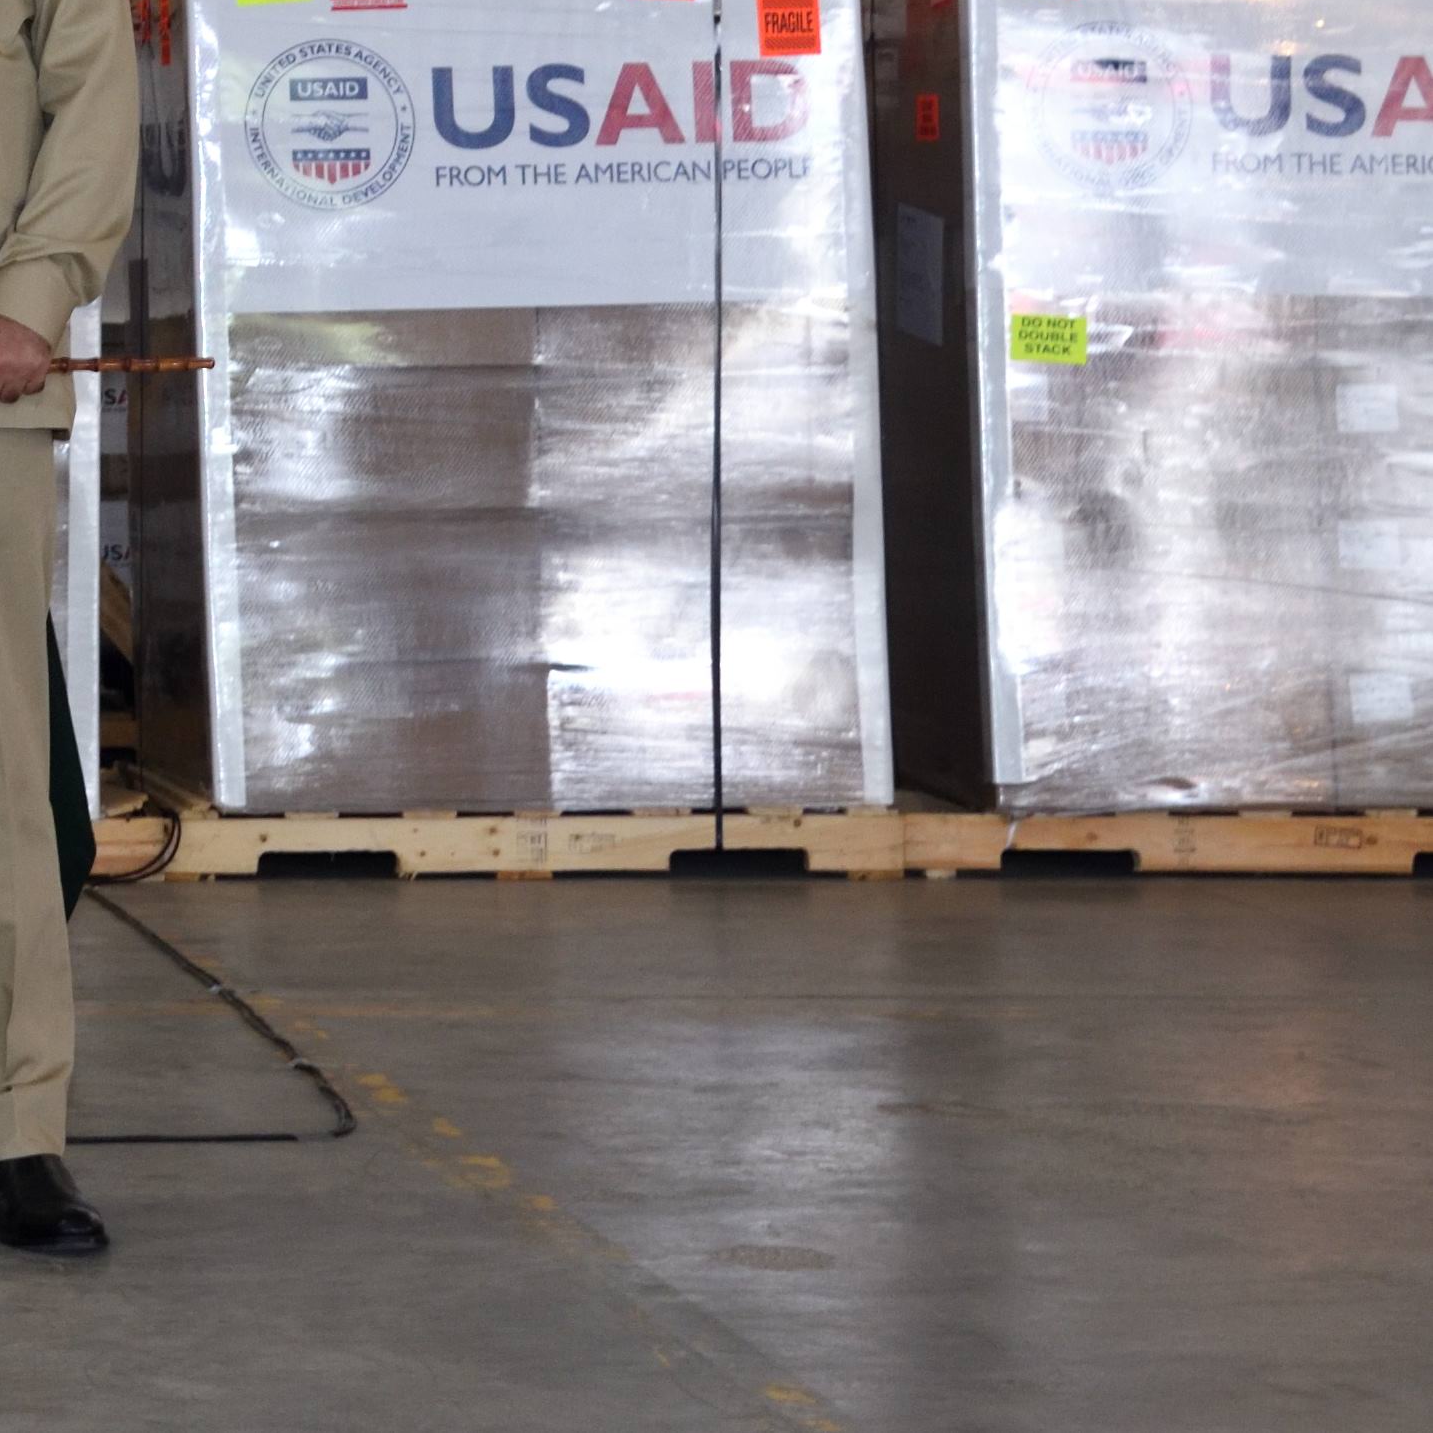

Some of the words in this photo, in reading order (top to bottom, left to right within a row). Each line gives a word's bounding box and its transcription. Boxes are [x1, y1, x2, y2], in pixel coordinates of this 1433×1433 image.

[764, 11, 814, 34] FRAGILE
[255, 52, 297, 99] UNITED
[299, 42, 352, 58] STATES
[354, 50, 404, 96] AGENCY
[297, 81, 359, 97] USAID
[432, 60, 809, 150] USAID
[249, 127, 339, 207] INTERNATIONAL
[342, 122, 413, 206] DEVELOPMENT
[435, 165, 508, 188] FROM
[515, 164, 567, 186] THE
[575, 159, 712, 185] AMERICAN
[1211, 152, 1283, 173] FROM
[1291, 152, 1343, 174] THE
[1022, 317, 1042, 327] DO
[1047, 318, 1075, 329] NOT
[1018, 329, 1078, 343] DOUBLE
[1024, 344, 1071, 355] STACK
